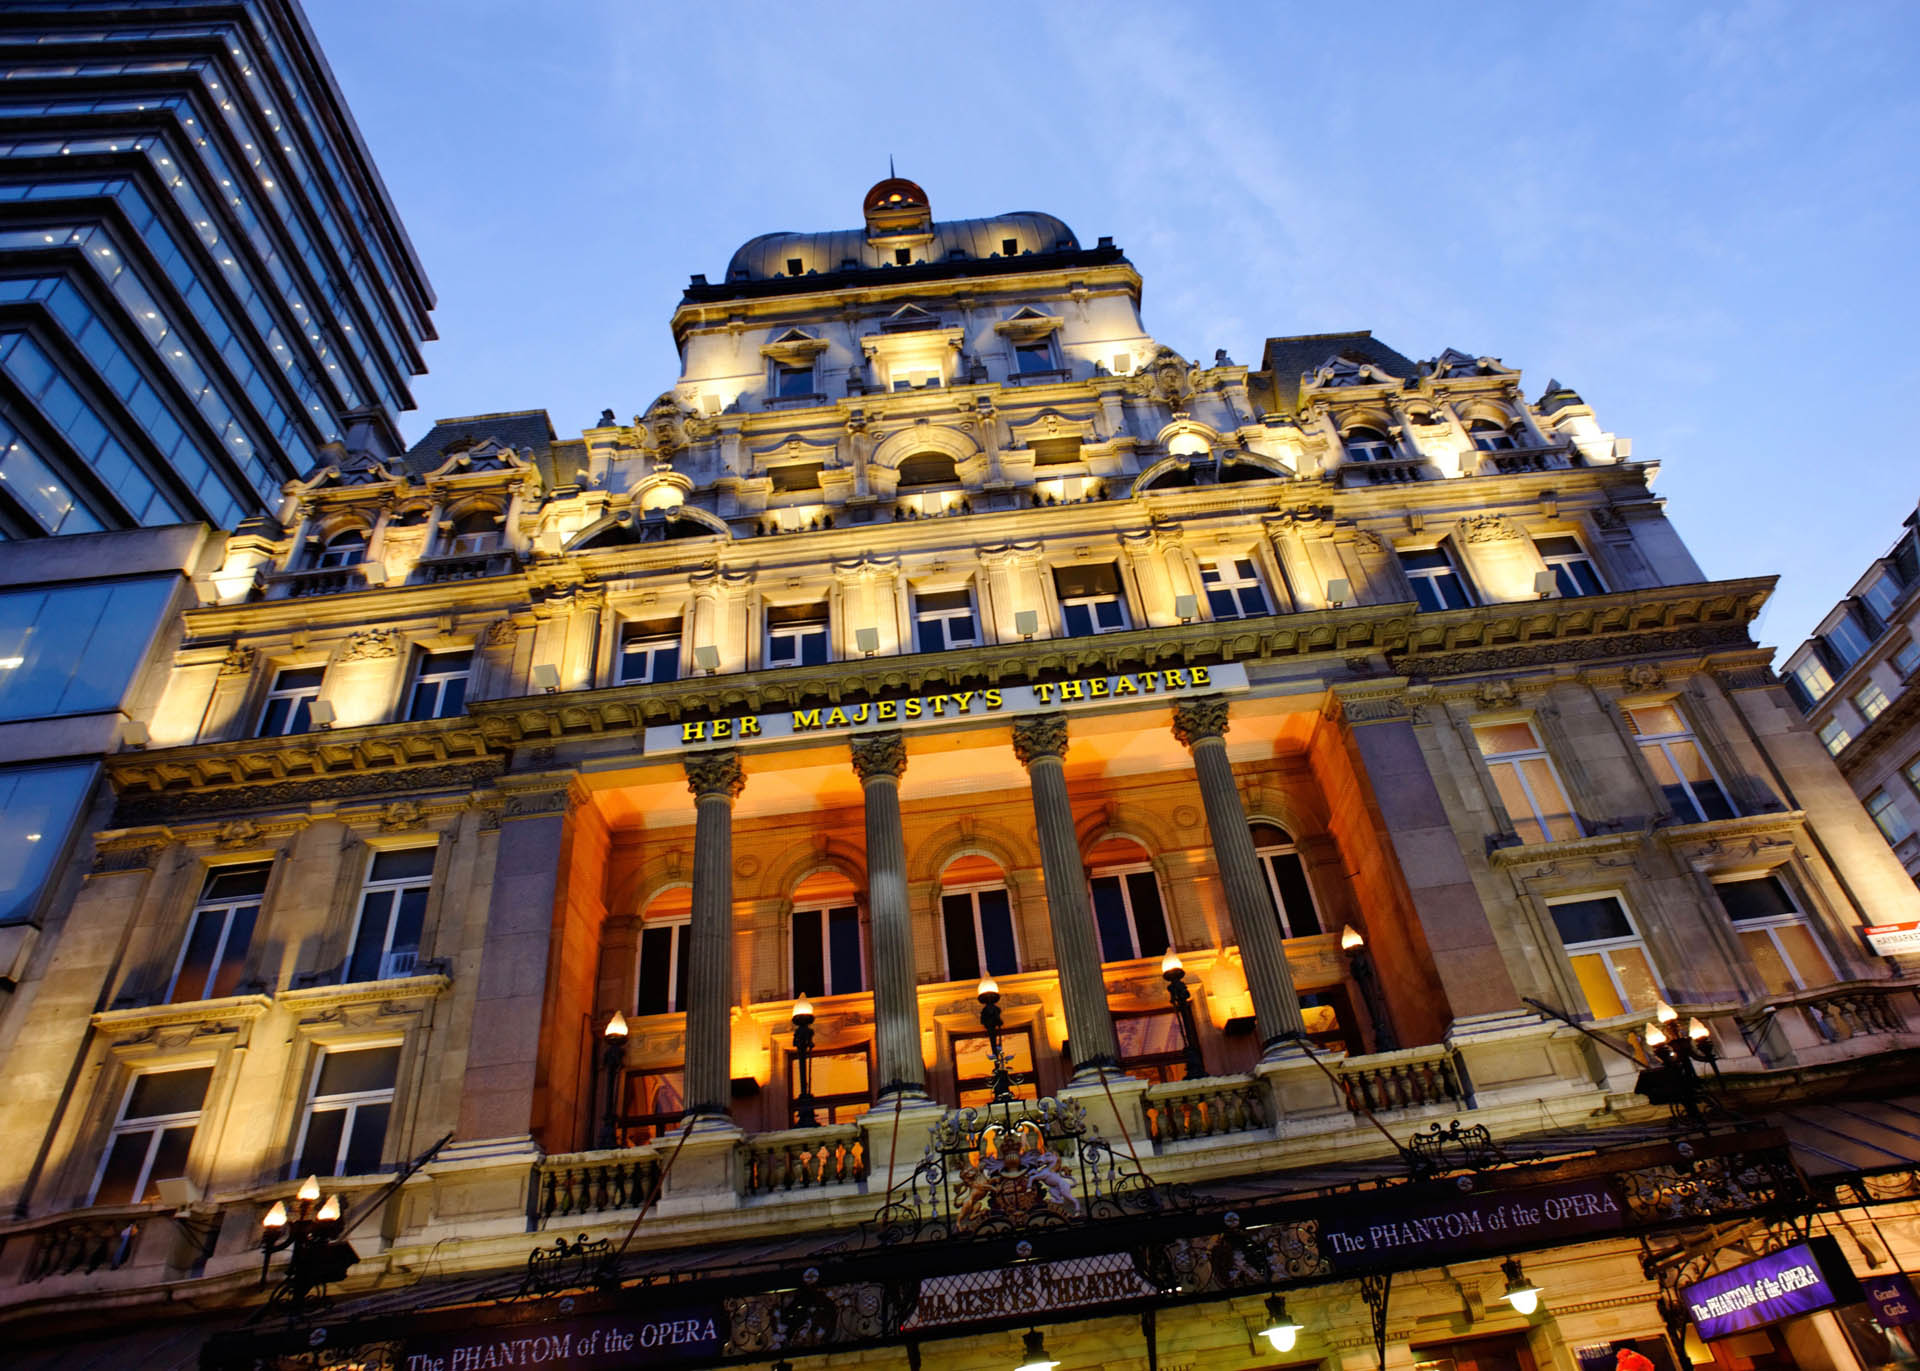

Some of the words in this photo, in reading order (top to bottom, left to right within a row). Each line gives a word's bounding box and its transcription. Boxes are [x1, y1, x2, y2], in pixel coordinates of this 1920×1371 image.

[682, 715, 761, 744] HER
[793, 689, 1002, 730] MAJESTY'S
[1034, 666, 1211, 702] THEATRE
[1327, 1232, 1366, 1253] The
[1369, 1210, 1483, 1249] PHANTOM
[1488, 1206, 1508, 1230] of
[1511, 1204, 1541, 1227] the
[1544, 1192, 1618, 1220] OPERA
[1046, 1269, 1143, 1305] THEATRE
[1691, 1303, 1711, 1321] The
[1706, 1285, 1757, 1317] PHANTOM
[1754, 1280, 1768, 1302] of
[1764, 1278, 1783, 1299] the
[1778, 1265, 1820, 1292] OPERA
[407, 1354, 444, 1371] The
[451, 1333, 573, 1371] PHANTOM
[577, 1330, 600, 1356] of
[604, 1328, 634, 1353] the
[640, 1318, 717, 1347] OPERA
